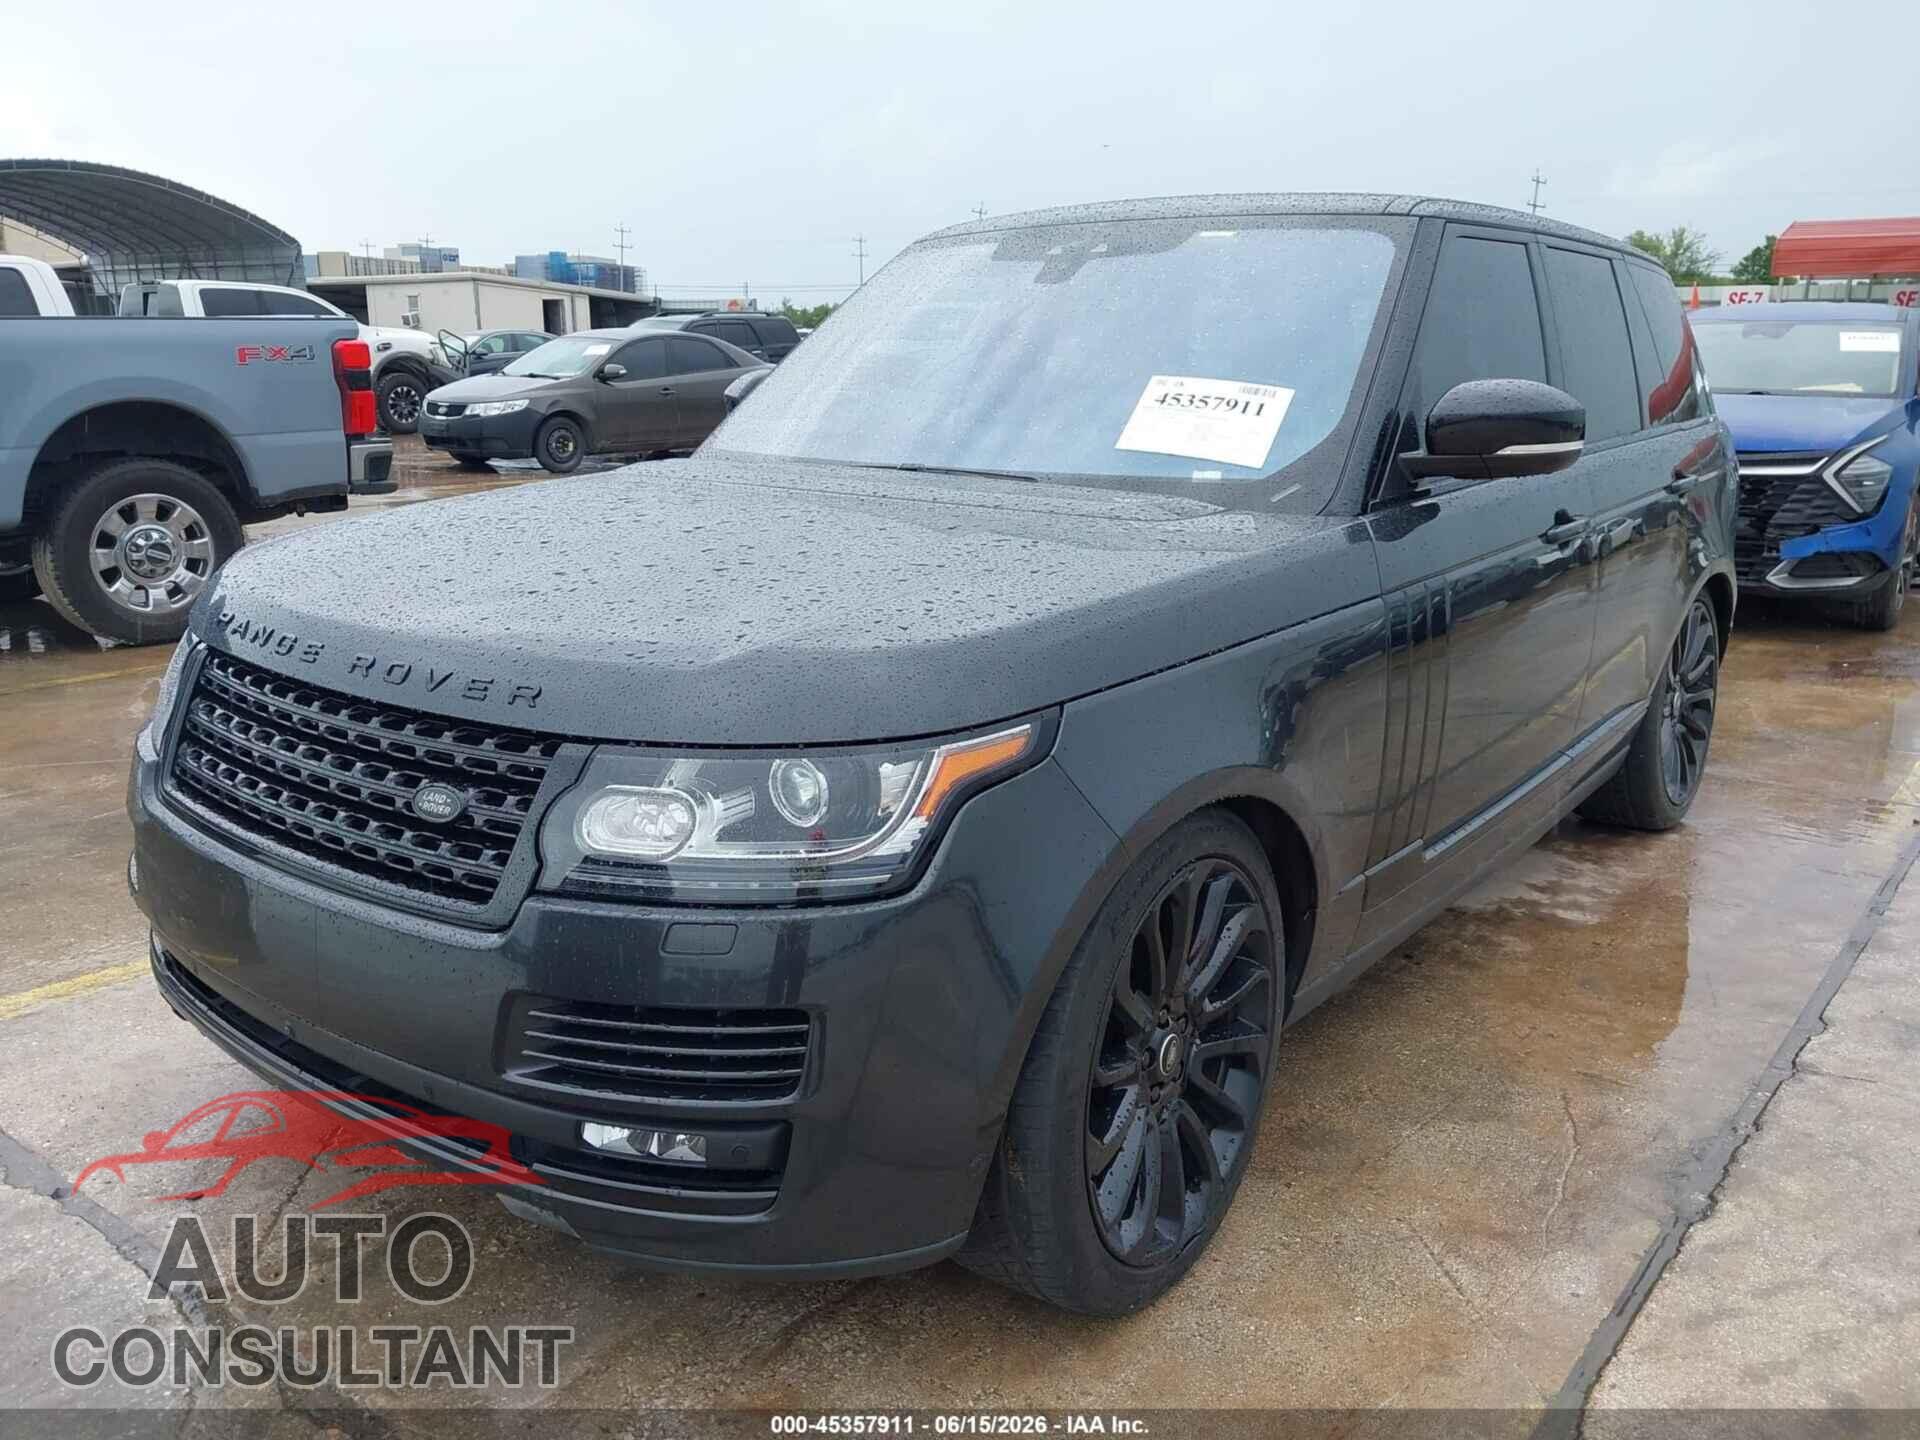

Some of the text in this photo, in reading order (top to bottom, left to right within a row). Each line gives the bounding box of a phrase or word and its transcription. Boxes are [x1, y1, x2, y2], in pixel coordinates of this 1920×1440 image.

[236, 344, 315, 367] FX4
[1153, 391, 1266, 418] 45357911
[347, 654, 544, 709] ROVER
[421, 801, 452, 816] ROVER
[423, 791, 447, 804] LAND
